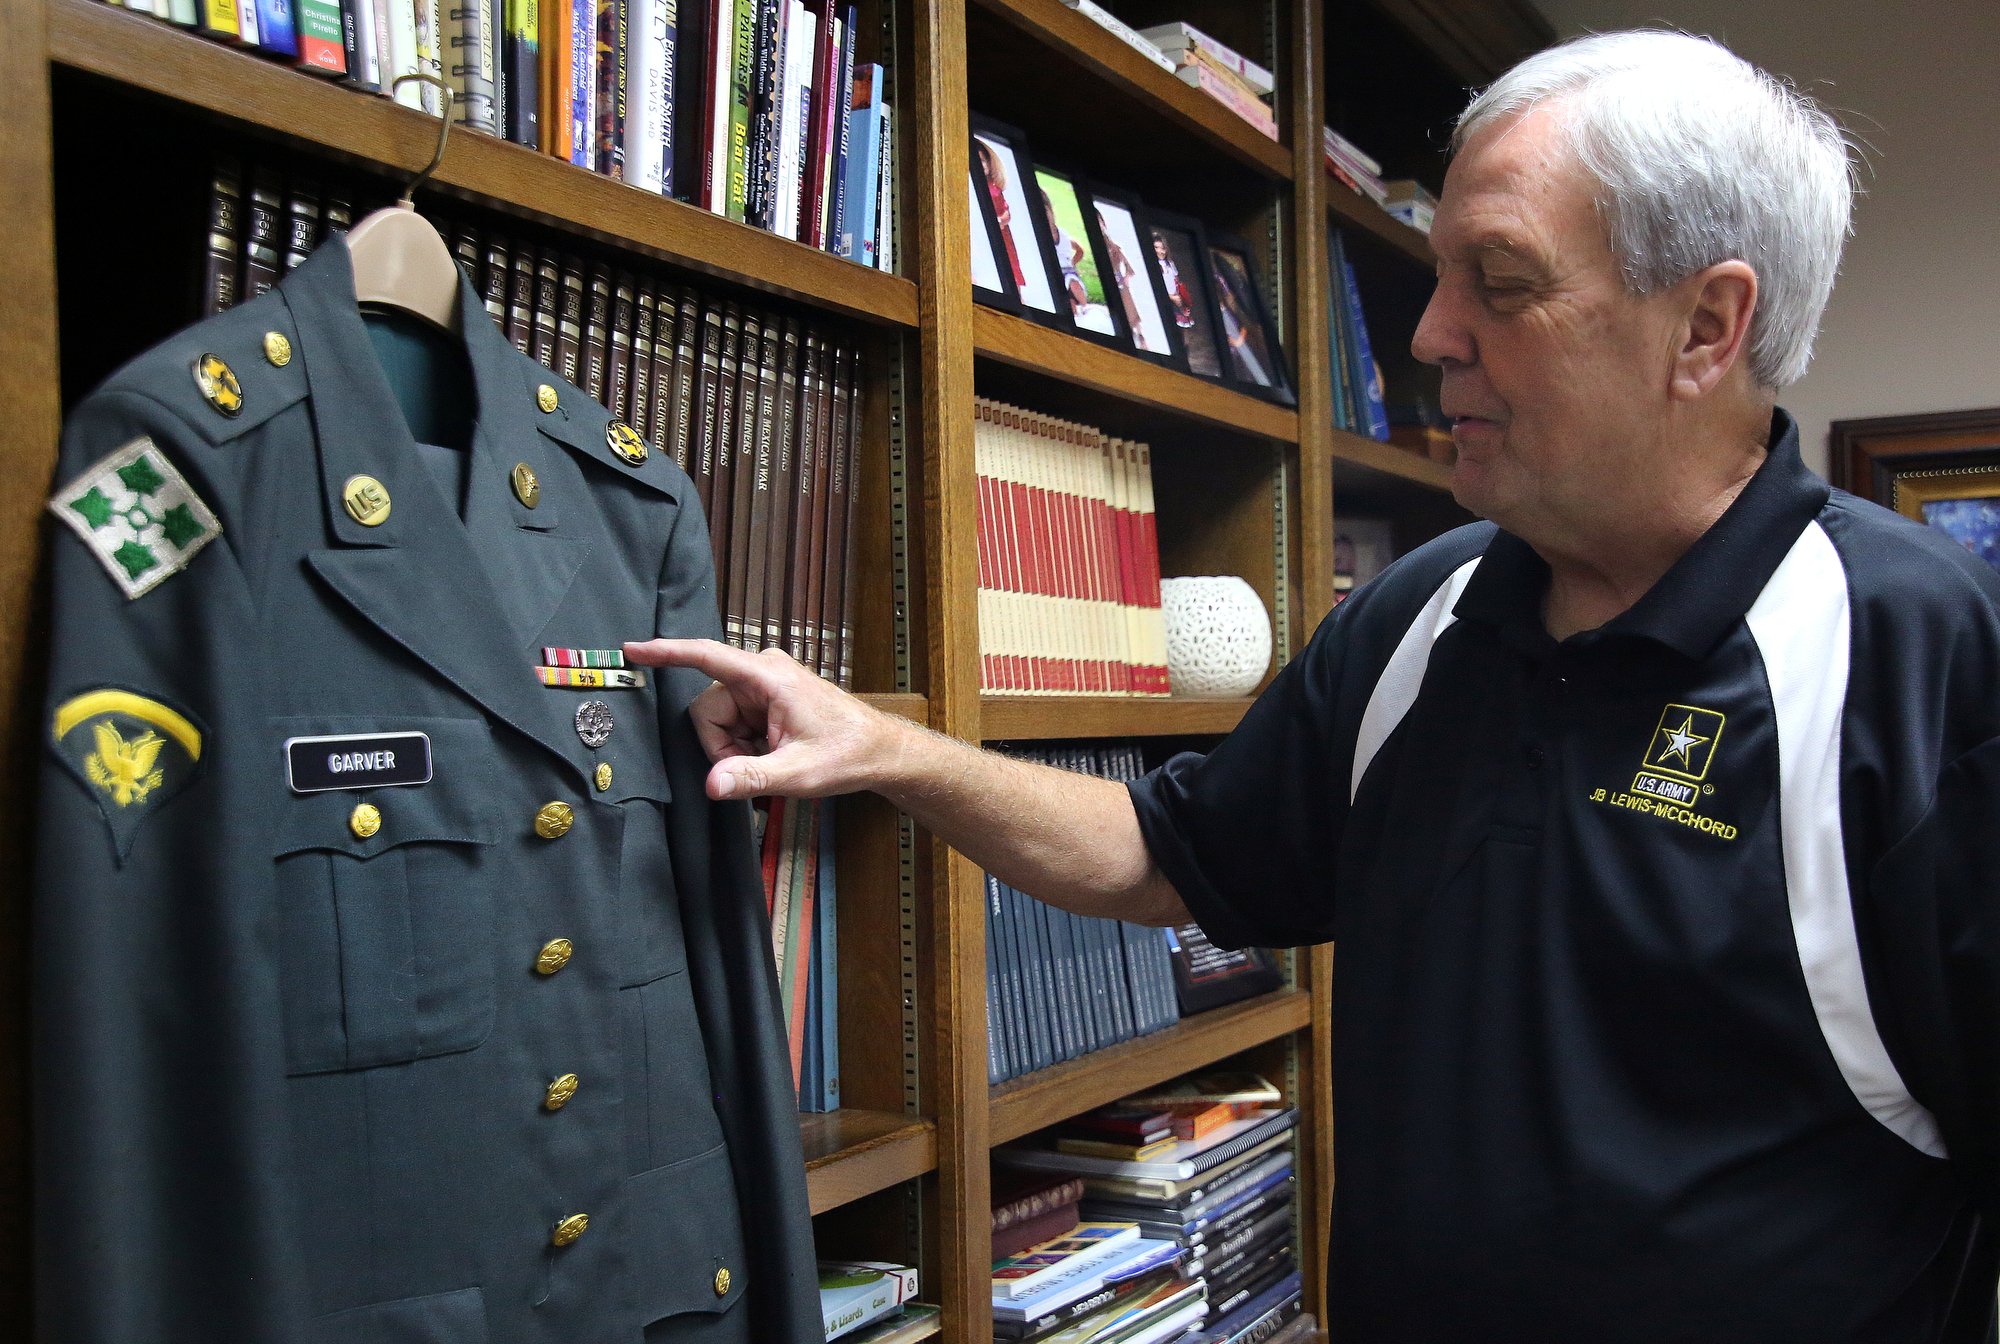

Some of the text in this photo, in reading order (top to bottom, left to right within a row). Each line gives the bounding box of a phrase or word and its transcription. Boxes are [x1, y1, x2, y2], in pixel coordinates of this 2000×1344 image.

[305, 9, 340, 25] Christina
[313, 22, 338, 36] Pirello
[319, 56, 338, 65] HOME
[482, 21, 491, 71] CALLS
[738, 13, 750, 108] PATTERSON
[759, 6, 770, 95] Mountains Wildflowers
[618, 103, 625, 119] ON
[661, 38, 675, 149] EMMITT SMITH
[801, 92, 810, 138] GARDEN
[841, 104, 851, 159] DELIGHT
[733, 122, 746, 204] Bear Cat
[518, 338, 528, 355] TH
[541, 343, 552, 368] THE
[565, 351, 576, 379] THE
[592, 355, 602, 381] THE
[615, 362, 627, 419] THE SCOU
[637, 368, 648, 392] THE
[655, 373, 669, 450] THE GUNFIGH
[677, 374, 692, 471] THE FRONTIERSM
[702, 382, 716, 476] THE EXPRESSMEN
[720, 386, 733, 467] THE GAMBLERS
[742, 390, 755, 455] THE MINERS
[781, 399, 793, 472] THE SOLDIERS
[758, 395, 773, 491] THE MEXICAN WAR
[802, 402, 816, 497] THE SPANISH WEST
[835, 434, 845, 494] CANADIANS
[331, 751, 395, 773] GARVER
[1637, 775, 1691, 802] U.S. ARMY
[1589, 788, 1737, 840] JB LEWIS-MCCHORD
[830, 1320, 838, 1333] &
[838, 1306, 864, 1328] Lizards
